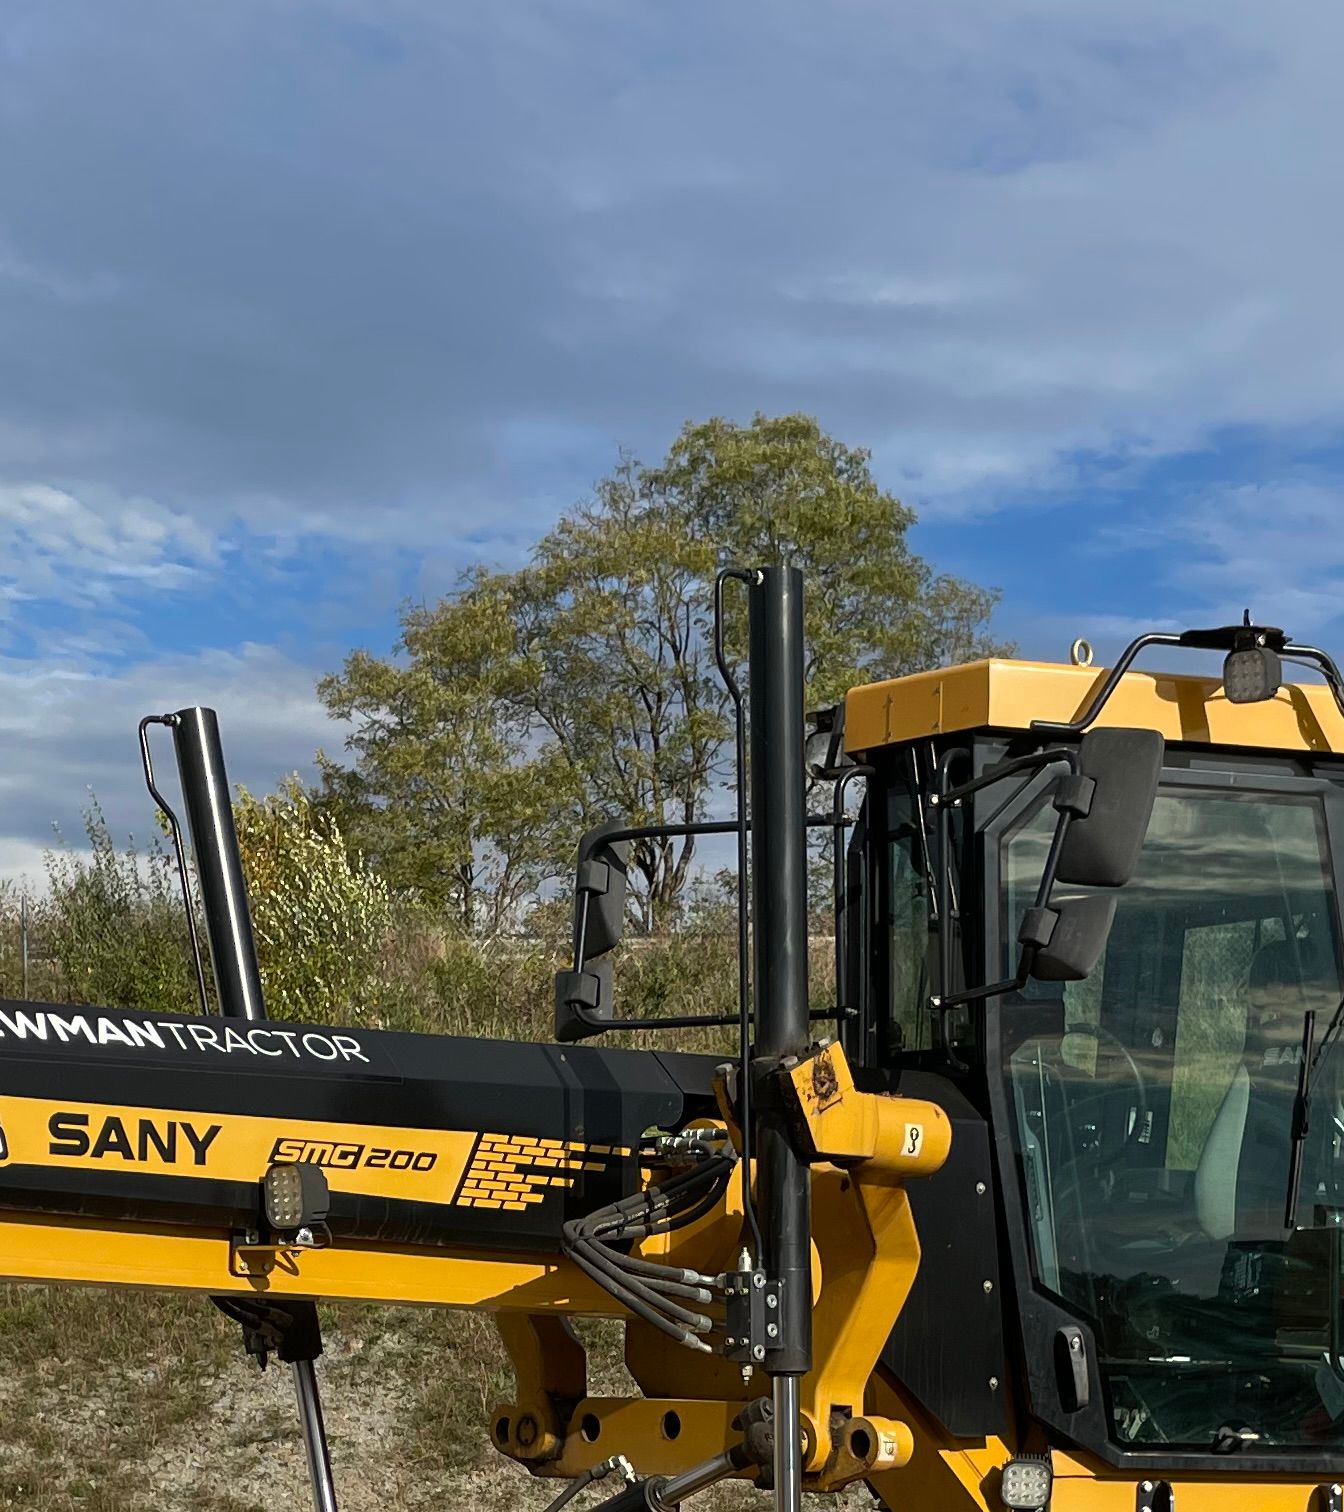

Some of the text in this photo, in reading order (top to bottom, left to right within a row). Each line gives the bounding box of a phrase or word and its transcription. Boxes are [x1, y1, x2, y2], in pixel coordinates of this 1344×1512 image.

[48, 1111, 223, 1166] SANY
[272, 1139, 438, 1172] SMG 200
